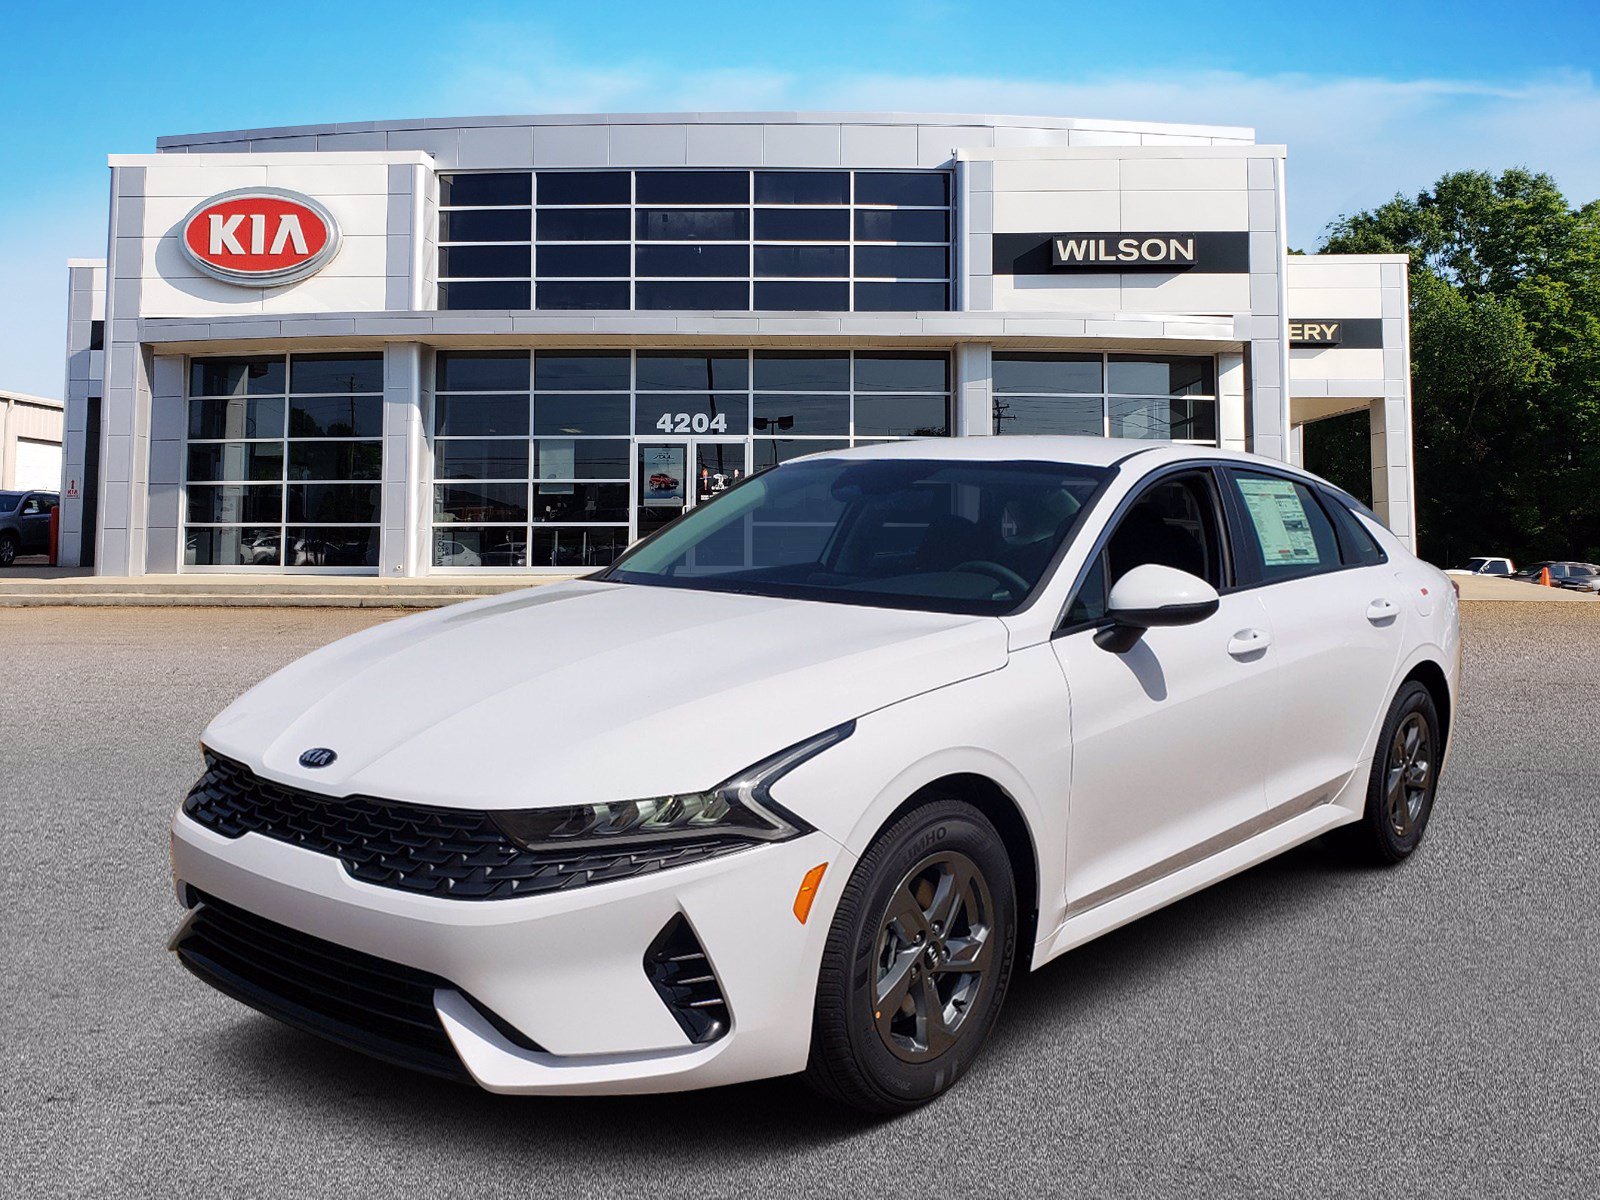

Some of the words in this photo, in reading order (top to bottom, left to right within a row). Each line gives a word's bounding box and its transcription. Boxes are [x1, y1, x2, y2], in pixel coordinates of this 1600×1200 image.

[208, 214, 309, 255] KIA
[1056, 238, 1193, 262] WILSON
[656, 412, 727, 433] 4204
[302, 749, 331, 765] KIA
